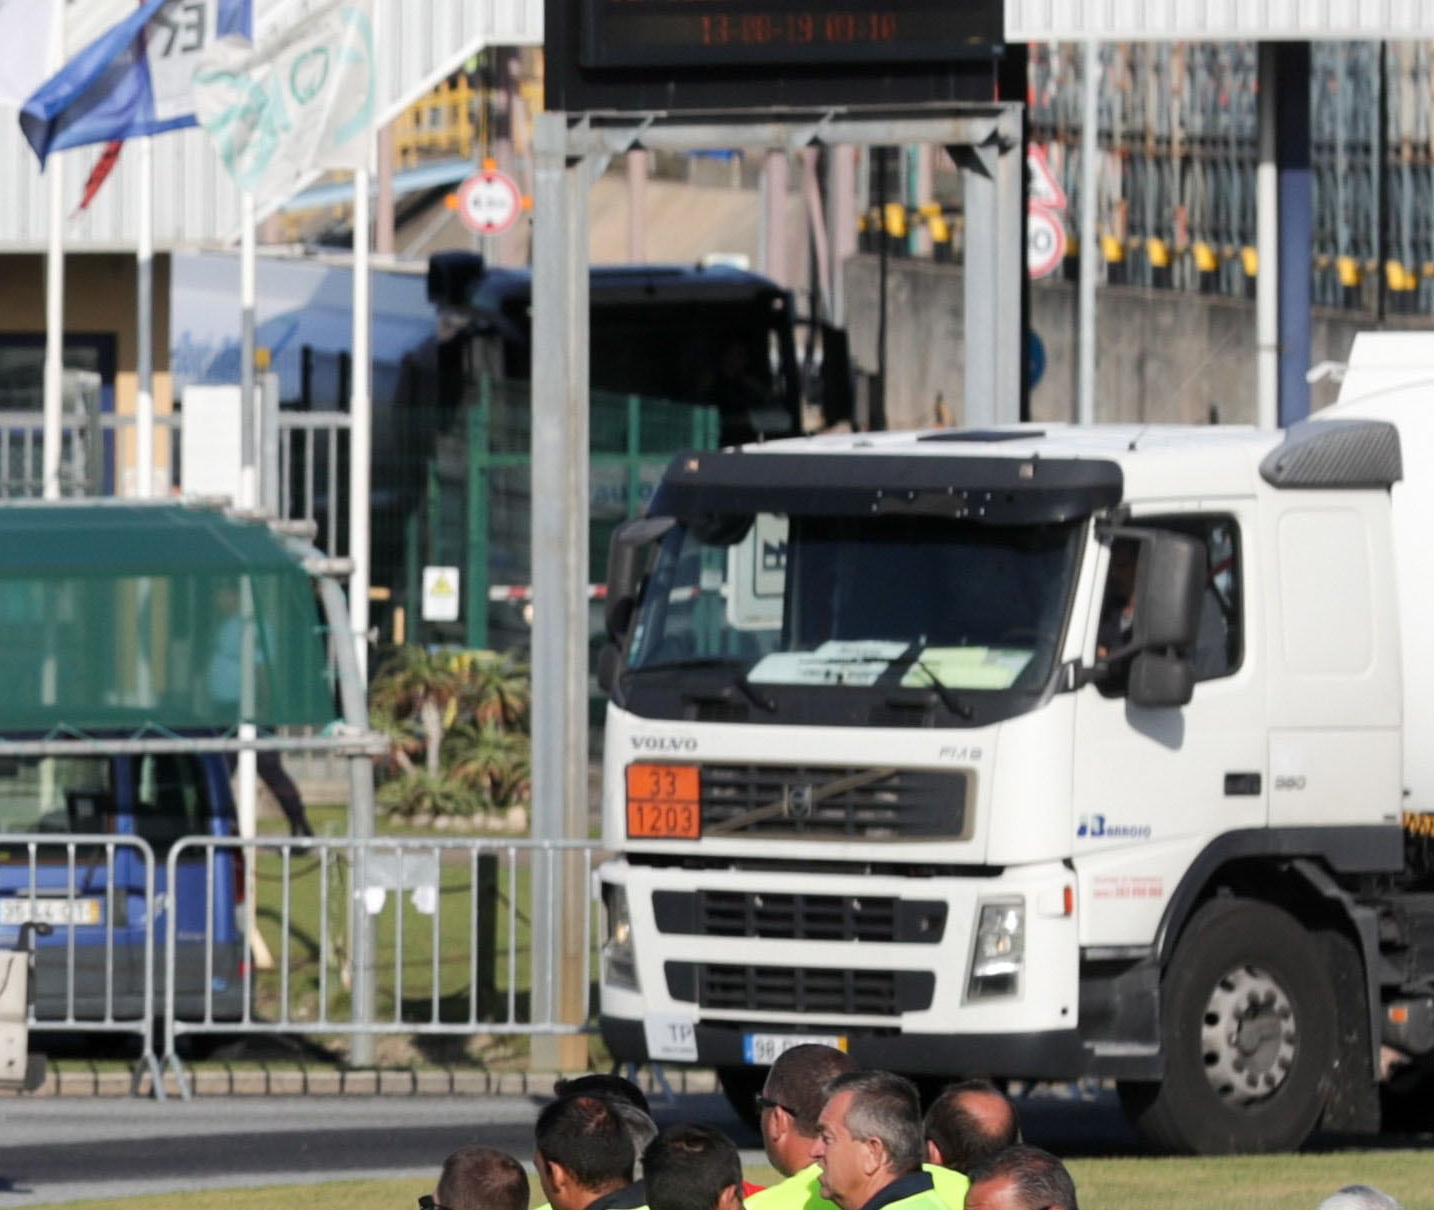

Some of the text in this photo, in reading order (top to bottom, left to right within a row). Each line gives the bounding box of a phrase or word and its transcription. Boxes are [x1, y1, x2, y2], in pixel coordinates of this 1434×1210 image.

[630, 737, 699, 752] VOLVO
[649, 770, 678, 800] 33
[634, 805, 694, 834] 1203
